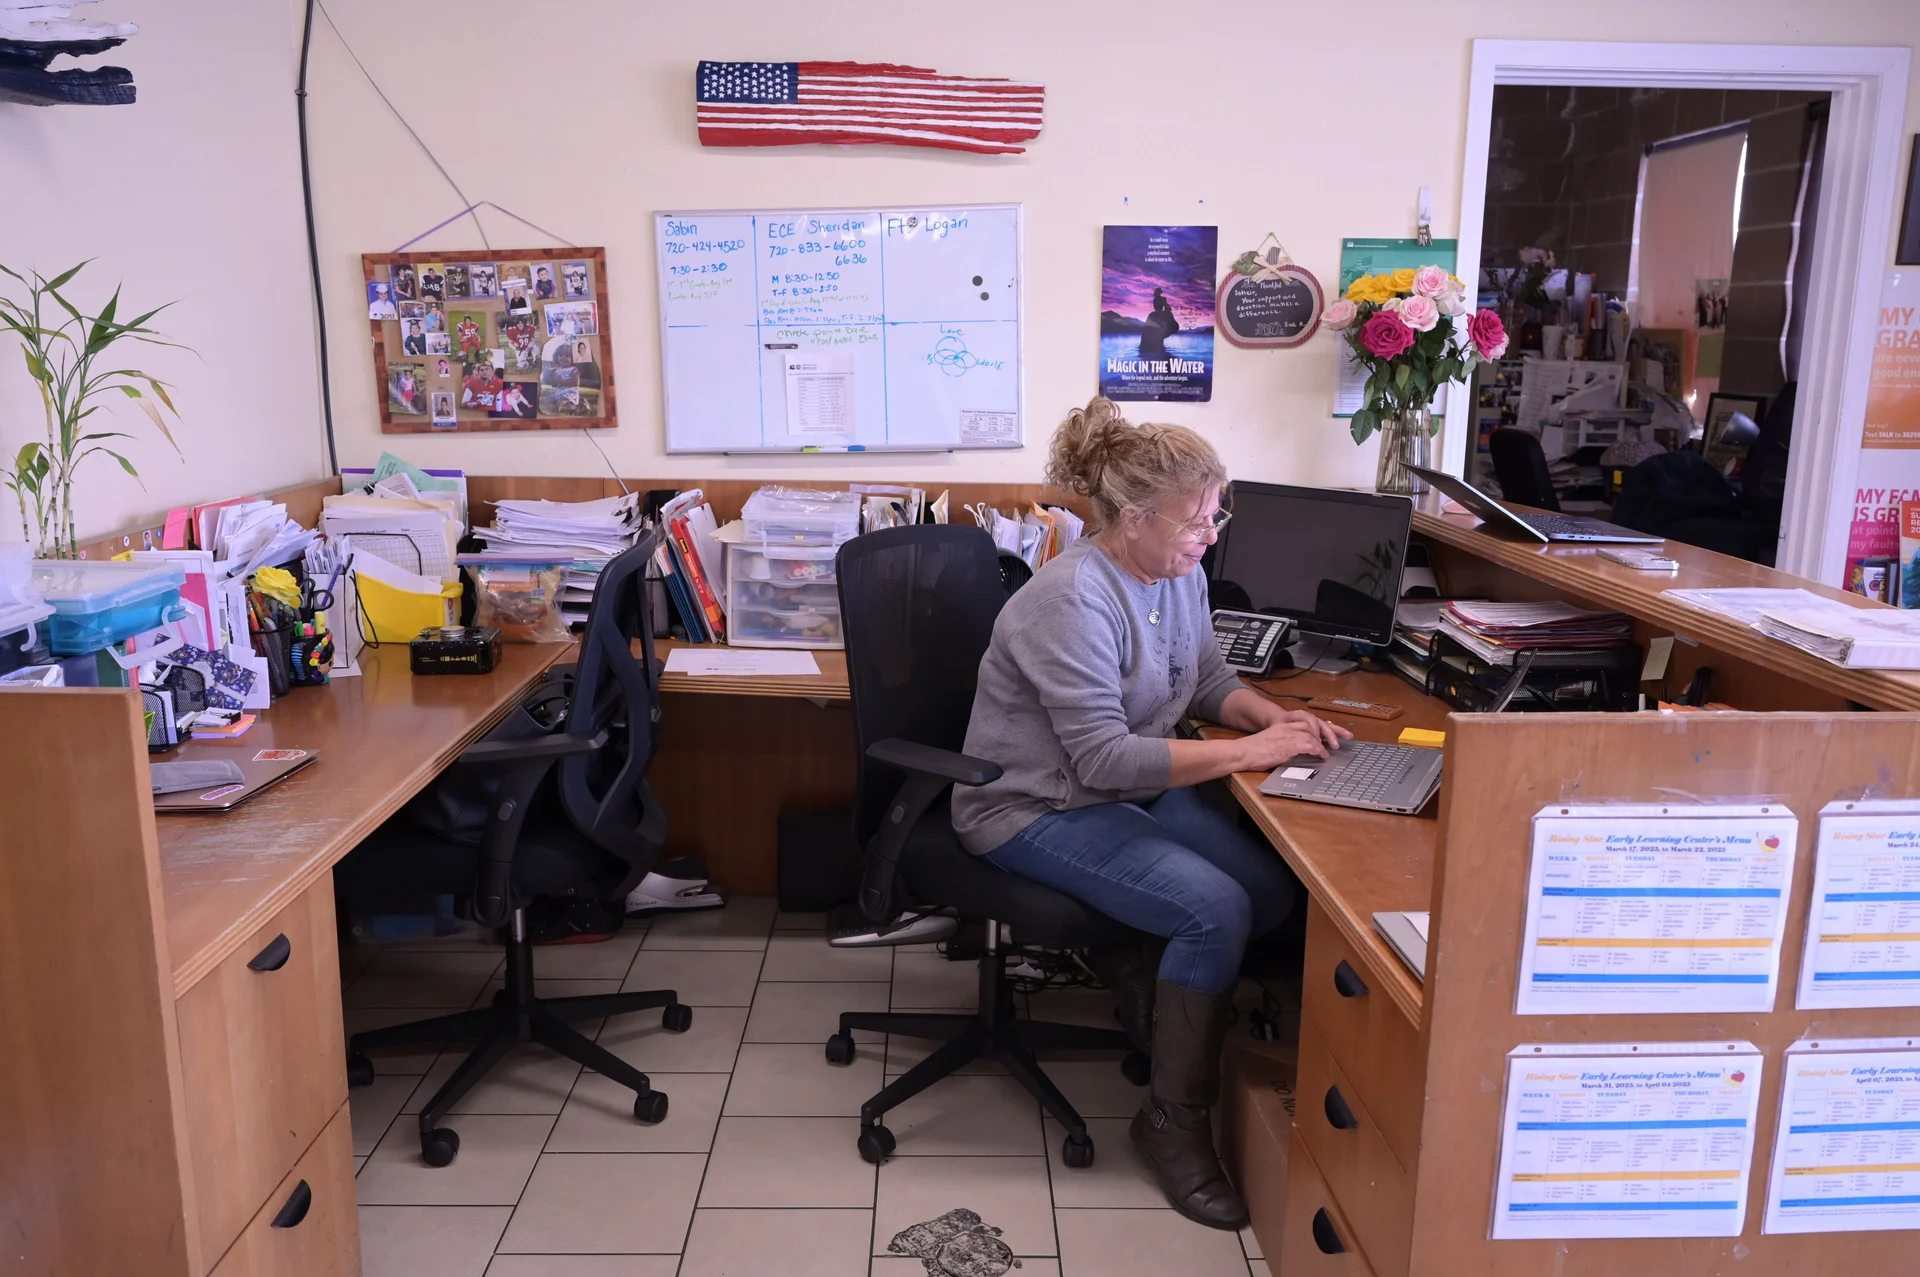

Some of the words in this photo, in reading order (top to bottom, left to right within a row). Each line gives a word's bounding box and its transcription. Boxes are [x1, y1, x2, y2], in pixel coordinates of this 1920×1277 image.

[665, 220, 698, 236] Sabin
[768, 222, 795, 239] ECE
[807, 218, 865, 235] Sheridan
[925, 217, 968, 238] Logan
[665, 239, 746, 254] 720-424-4520
[835, 253, 868, 266] 6636
[772, 275, 780, 284] M
[1258, 294, 1280, 303] support
[1238, 310, 1281, 318] difference.
[1879, 306, 1916, 326] MY
[1107, 358, 1137, 373] MAGIC
[1138, 360, 1149, 373] IN
[1150, 360, 1168, 374] THE
[1169, 357, 1205, 374] WATER
[1872, 366, 1902, 381] good
[1855, 488, 1886, 504] MY
[1853, 506, 1870, 522] IS
[1852, 525, 1865, 535] at
[1850, 541, 1867, 552] my
[1548, 834, 1581, 845] Rising
[1605, 834, 1635, 845] Early
[1635, 835, 1682, 845] Learning
[1683, 835, 1722, 844] Center's
[1722, 836, 1752, 844] Menu
[1832, 832, 1864, 842] Rising
[1887, 831, 1916, 841] Early
[1525, 1072, 1556, 1082] Rising
[1580, 1072, 1609, 1081] Early
[1609, 1071, 1654, 1081] Learning
[1656, 1071, 1692, 1079] Center's
[1692, 1071, 1721, 1079] Menu
[1797, 1069, 1827, 1078] Rising
[1850, 1067, 1879, 1076] Early
[1270, 1081, 1292, 1095] DO
